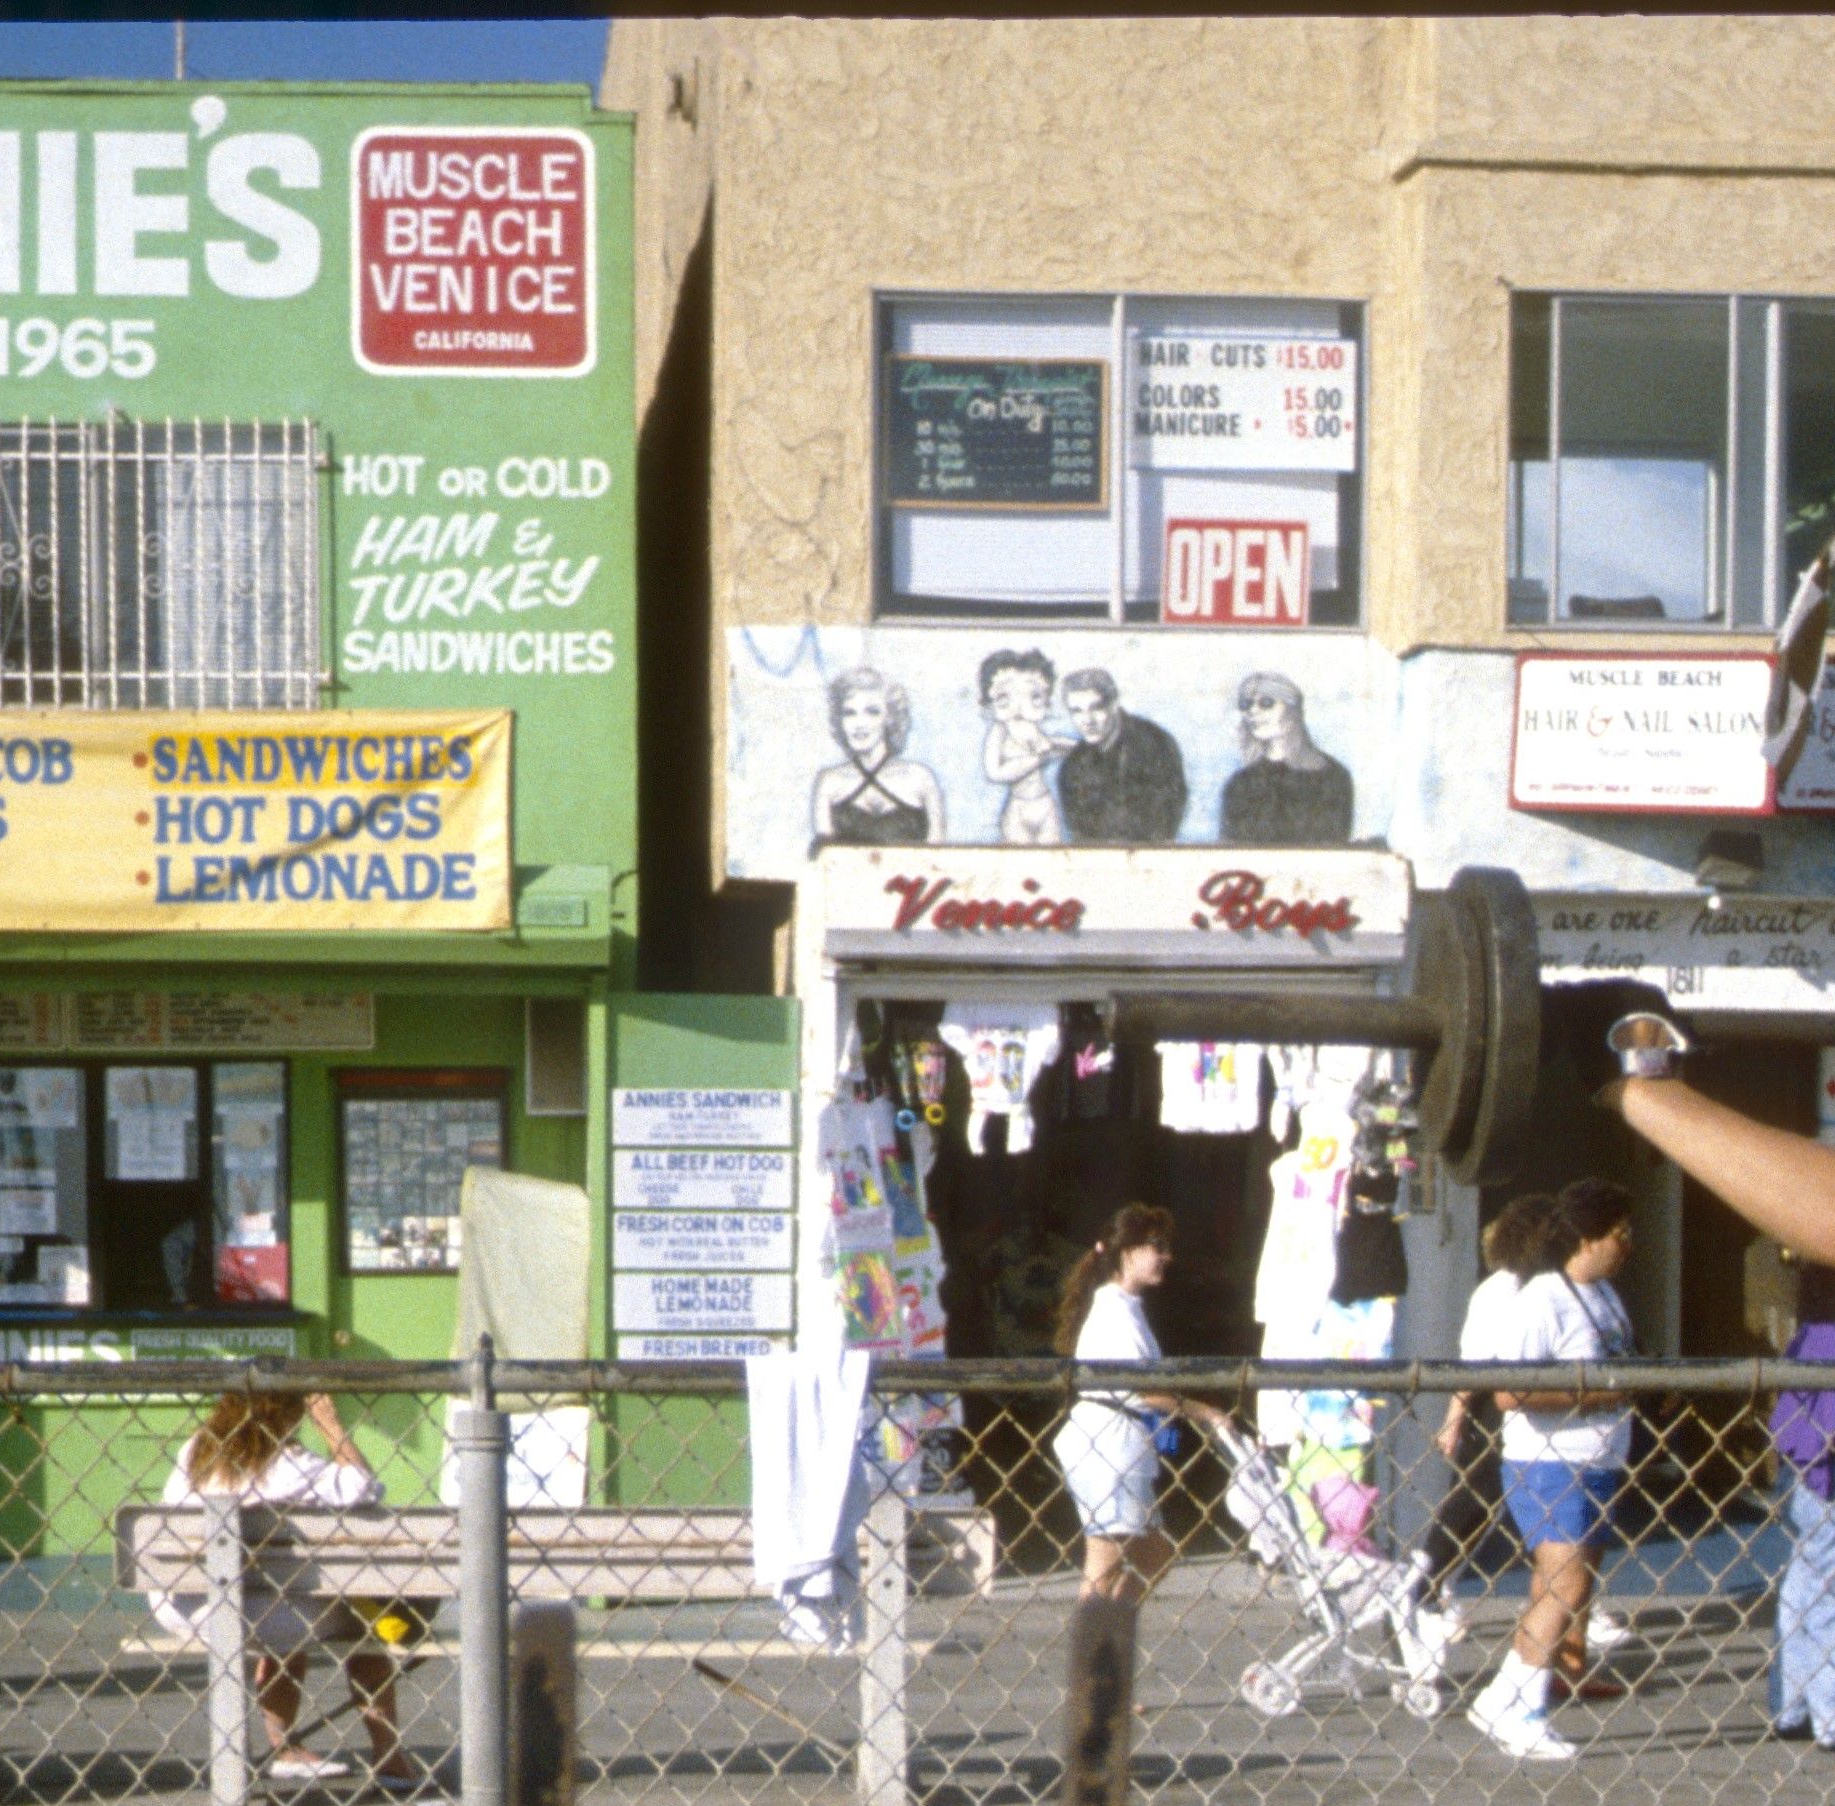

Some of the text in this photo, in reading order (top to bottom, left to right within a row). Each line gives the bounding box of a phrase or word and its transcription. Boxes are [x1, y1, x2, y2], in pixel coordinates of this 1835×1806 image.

[368, 152, 577, 201] MUSCLE
[385, 209, 564, 258] BEACH
[369, 264, 578, 314] VENICE
[414, 329, 535, 352] CALIFORNIA
[1139, 341, 1190, 367] HAIR
[1211, 342, 1266, 369] CUTS
[1138, 383, 1342, 412] COLORS 15.00
[1135, 411, 1242, 438] MANICURE
[342, 453, 612, 499] HOT OR COLD
[350, 511, 555, 569] HAM &
[1168, 527, 1304, 621] OPEN
[349, 555, 602, 627] TURKEY
[342, 629, 616, 675] SANDWICHES
[1569, 669, 1723, 687] MUSCLE BEACH
[1523, 708, 1579, 732] HAIR
[1623, 708, 1673, 733] NAIL
[1687, 709, 1768, 735] SALON
[151, 734, 474, 785] SANDWICHES
[153, 793, 443, 846] HOT DOGS
[153, 852, 478, 904] LEMONADE
[885, 874, 1086, 933] Venice
[1552, 911, 1599, 931] are
[1610, 909, 1661, 931] one
[1689, 904, 1814, 939] haircut
[1764, 944, 1823, 969] star
[623, 1091, 782, 1108] ANNIES SANDWICH
[631, 1154, 784, 1172] ALL BEEF HOT DOG
[618, 1215, 785, 1233] FRESH CORN ON COB
[651, 1277, 754, 1294] HOME MADE
[655, 1294, 754, 1313] LEMONADE
[643, 1338, 773, 1357] FRESH BREWED
